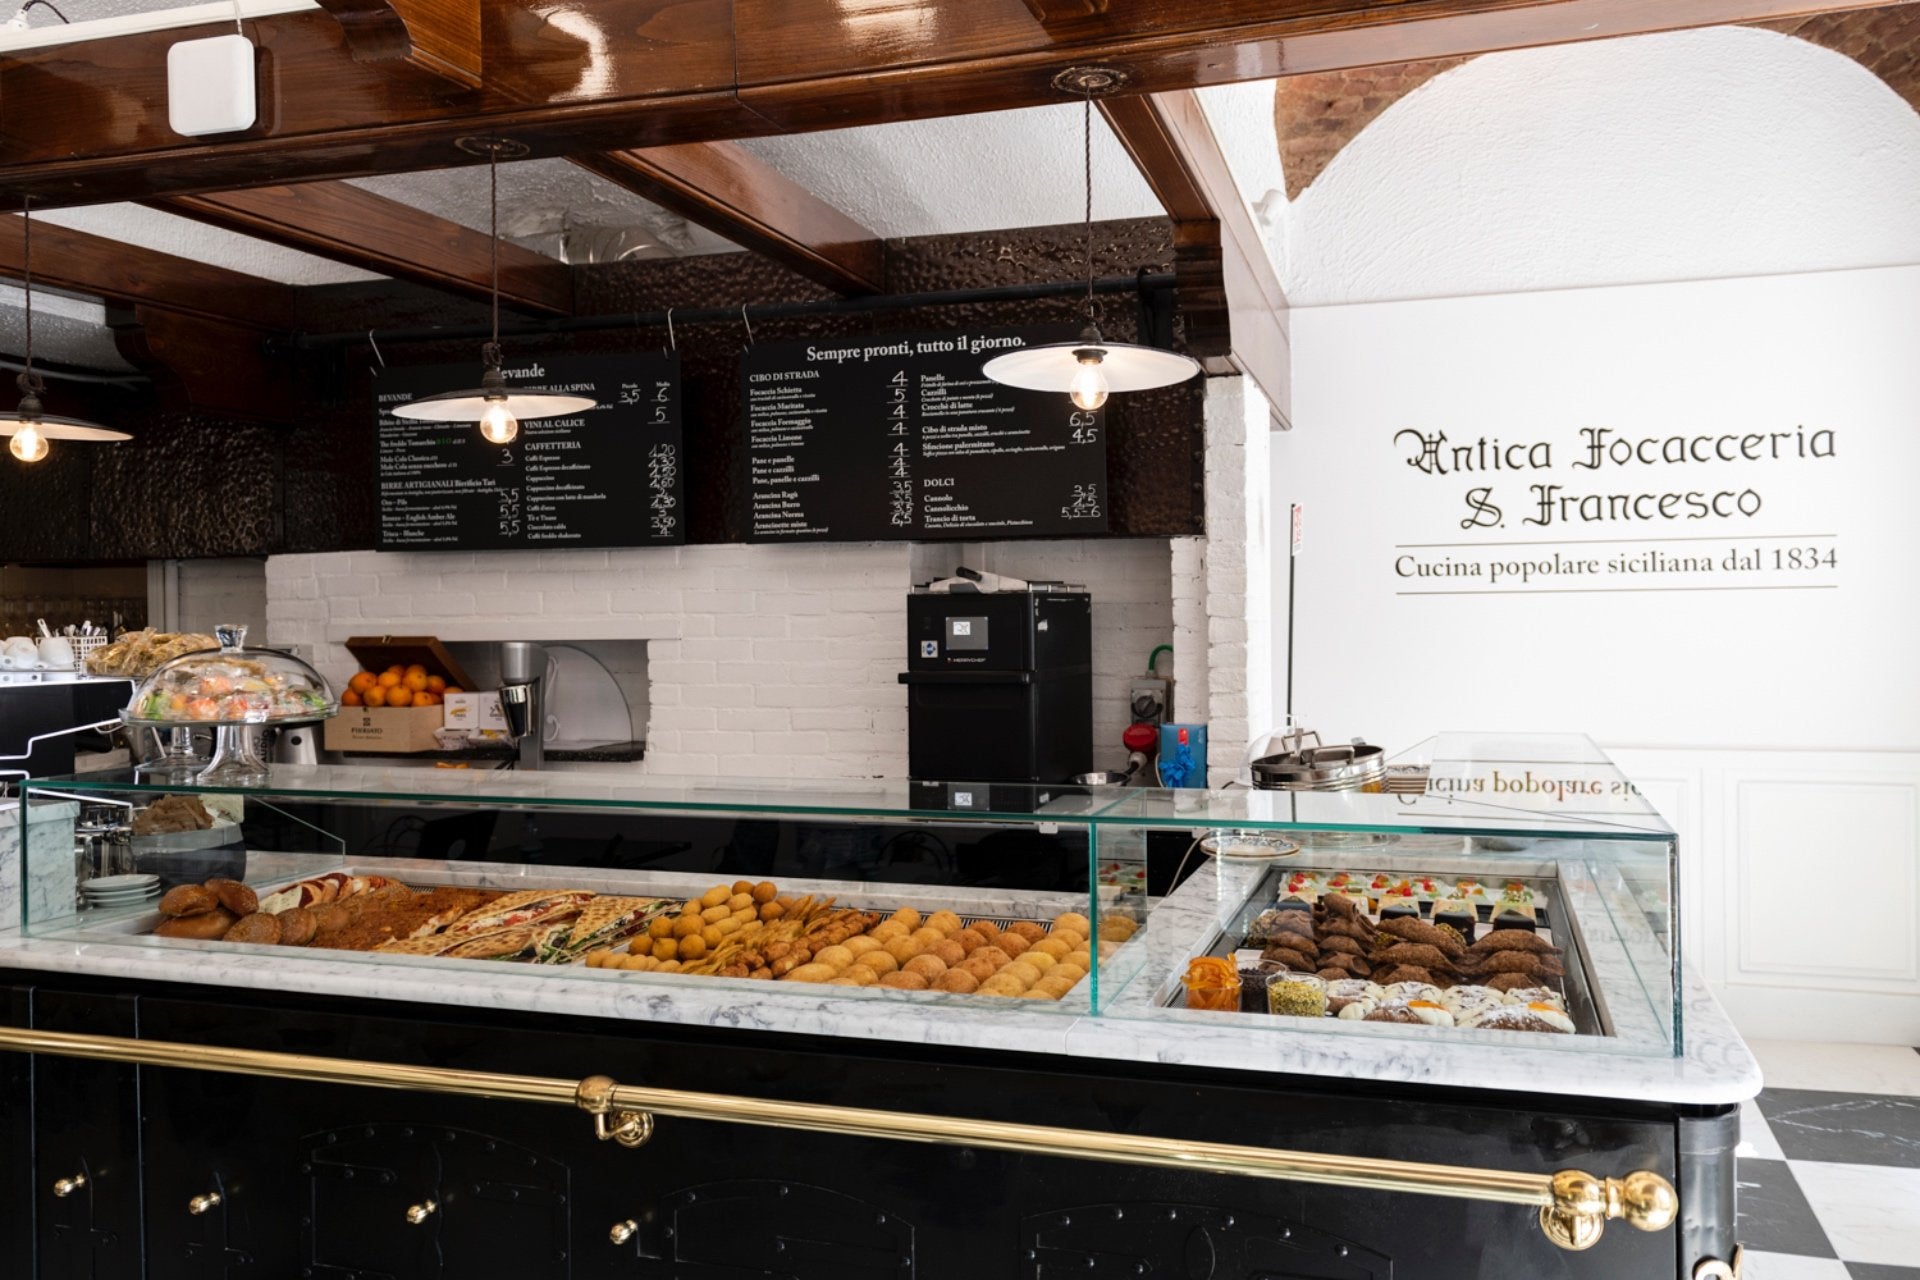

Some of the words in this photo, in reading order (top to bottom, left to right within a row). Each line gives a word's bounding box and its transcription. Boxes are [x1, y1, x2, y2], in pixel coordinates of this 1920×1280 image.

[807, 346, 860, 363] Sempre
[864, 341, 913, 361] pronti,
[917, 340, 953, 353] tutto
[957, 335, 967, 350] il
[971, 335, 1026, 353] giorno.
[498, 363, 545, 379] evande
[749, 374, 771, 382] CIBO
[773, 373, 783, 381] DI
[784, 370, 820, 380] STRADA
[892, 370, 908, 387] 4
[920, 374, 945, 382] Panelle
[549, 384, 570, 392] ALLA
[571, 383, 595, 391] SPINA
[750, 388, 776, 396] Focaccia
[776, 386, 802, 394] Schietta
[378, 393, 412, 402] BEVANDE
[657, 387, 668, 402] 6
[894, 388, 907, 403] 5
[750, 404, 776, 412] Focaccia
[777, 402, 804, 410] Maritata
[958, 401, 973, 409] latte
[655, 407, 667, 422] 5
[892, 404, 907, 420] 4
[525, 420, 541, 429] VINI
[541, 420, 554, 428] AL
[555, 418, 585, 427] CALICE
[751, 420, 777, 428] Focaccia
[778, 417, 811, 426] Formaggio
[1070, 411, 1097, 429] 6,5
[892, 421, 908, 436] 4
[922, 425, 938, 434] Cibo
[939, 425, 947, 433] di
[947, 424, 968, 432] strada
[969, 423, 988, 431] misto
[751, 435, 777, 443] Focaccia
[778, 433, 802, 441] Limone
[1071, 428, 1098, 444] 4,5
[525, 441, 581, 450] CAFFETTERIA
[892, 442, 908, 457] 4
[922, 442, 953, 451] Sfincione
[954, 440, 995, 450] palermitano
[1393, 427, 1554, 475] Antica
[1571, 424, 1838, 471] Focacceria
[501, 448, 513, 464] 3
[752, 457, 767, 465] Pane
[772, 455, 795, 465] panelle
[752, 467, 767, 475] Pane
[381, 482, 404, 490] BIRRE
[404, 480, 454, 490] ARTIGIANALI
[752, 477, 770, 485] Pane,
[770, 475, 792, 485] panelle
[923, 478, 954, 487] DOLCI
[500, 488, 520, 505] 5,5
[752, 492, 781, 500] Arancina
[924, 494, 953, 503] Cannolo
[753, 502, 781, 510] Arancina
[782, 500, 800, 509] Burro
[924, 503, 969, 513] Cannolicchio
[1460, 486, 1506, 530] S.
[1522, 482, 1763, 526] Francesco
[500, 504, 520, 520] 5,5
[753, 512, 781, 520] Arancina
[782, 510, 804, 519] Norma
[924, 514, 950, 523] Trancio
[951, 513, 959, 522] di
[959, 513, 976, 522] torta
[500, 519, 521, 537] 5,5
[1394, 553, 1482, 578] Cucina
[1489, 551, 1600, 583] popolare
[1608, 549, 1714, 574] siciliana
[1722, 548, 1762, 571] dal
[1773, 546, 1838, 571] 1834
